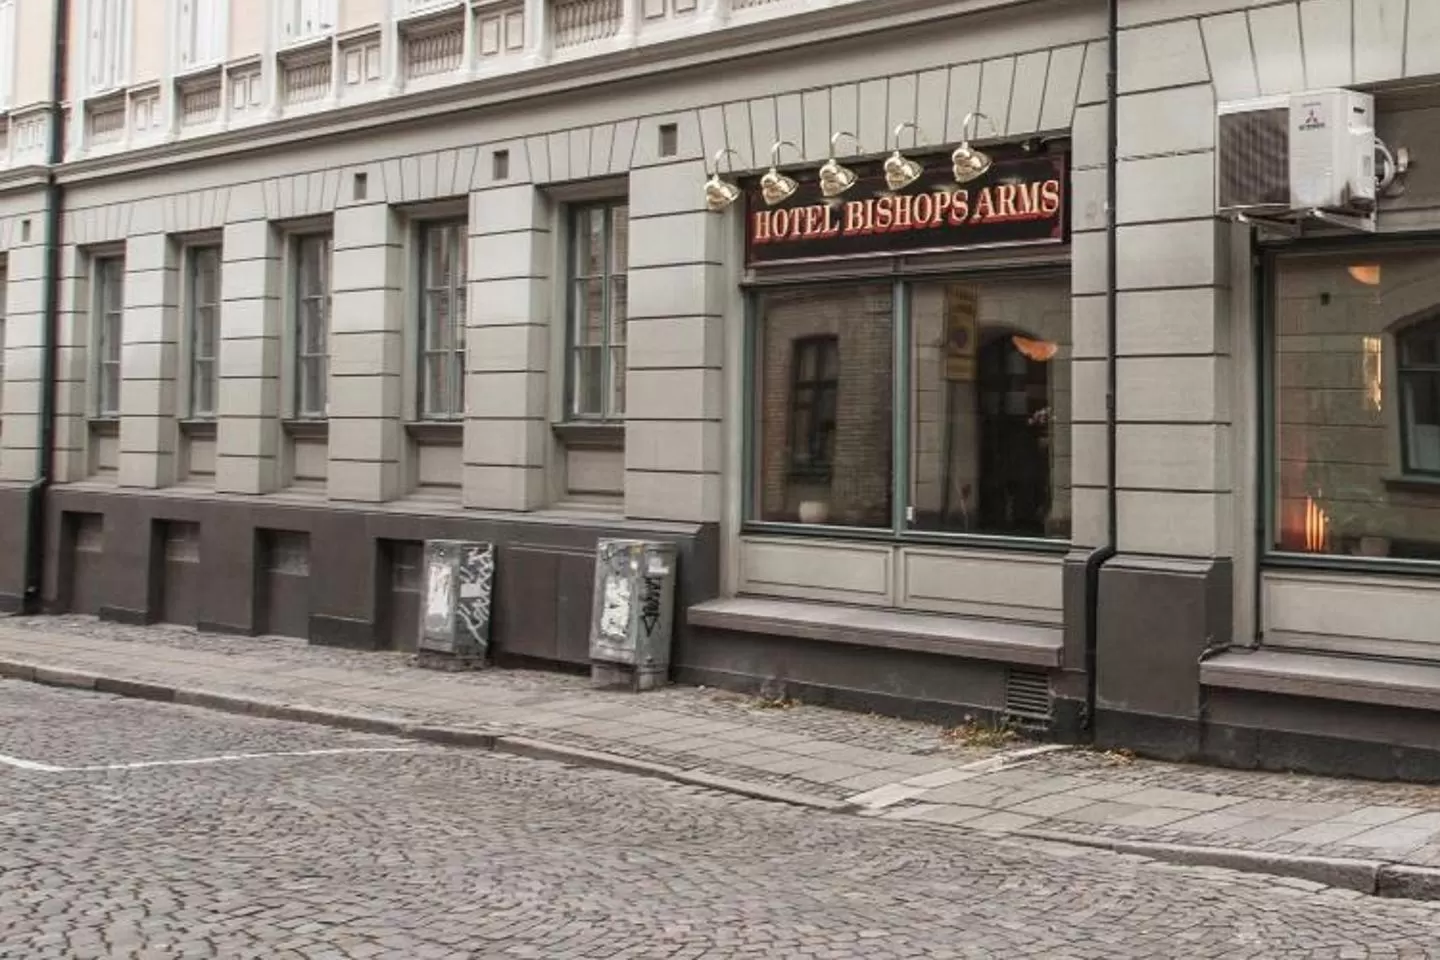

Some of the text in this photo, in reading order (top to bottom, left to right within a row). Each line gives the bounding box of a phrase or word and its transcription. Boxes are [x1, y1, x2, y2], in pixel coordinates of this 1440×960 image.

[755, 179, 1060, 239] HOTEL BISHOPS ARMS
